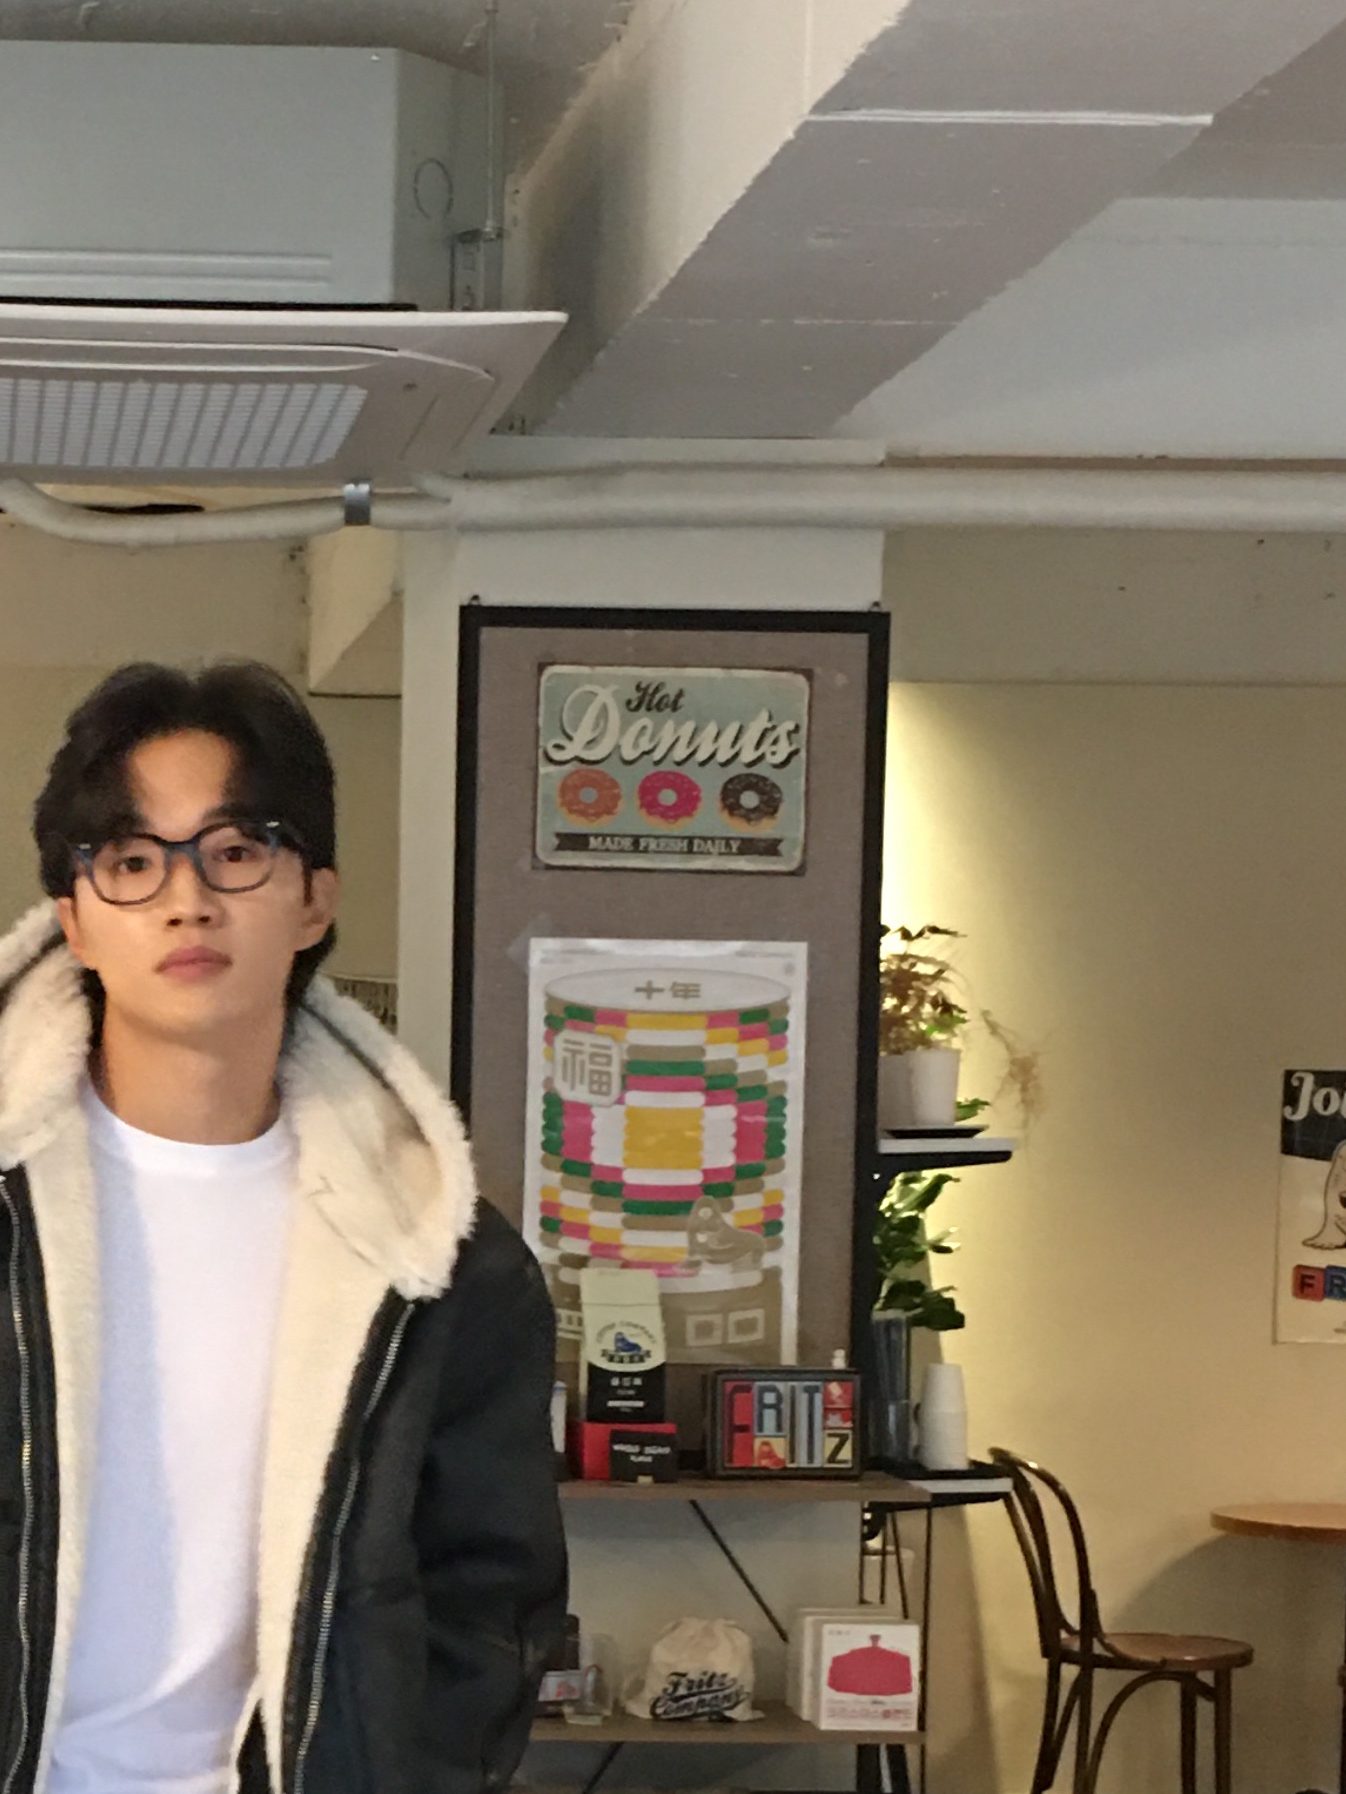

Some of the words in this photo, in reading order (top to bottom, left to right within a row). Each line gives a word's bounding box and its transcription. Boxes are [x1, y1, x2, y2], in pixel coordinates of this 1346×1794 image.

[625, 681, 686, 713] Hot
[543, 684, 801, 769] Donuts
[589, 836, 634, 851] MADE
[639, 838, 688, 852] FRESH
[693, 838, 742, 853] DAILY
[634, 979, 702, 1000] 十年
[562, 1039, 613, 1097] 福
[1284, 1072, 1346, 1120] Jo
[728, 1384, 850, 1465] FRITZ
